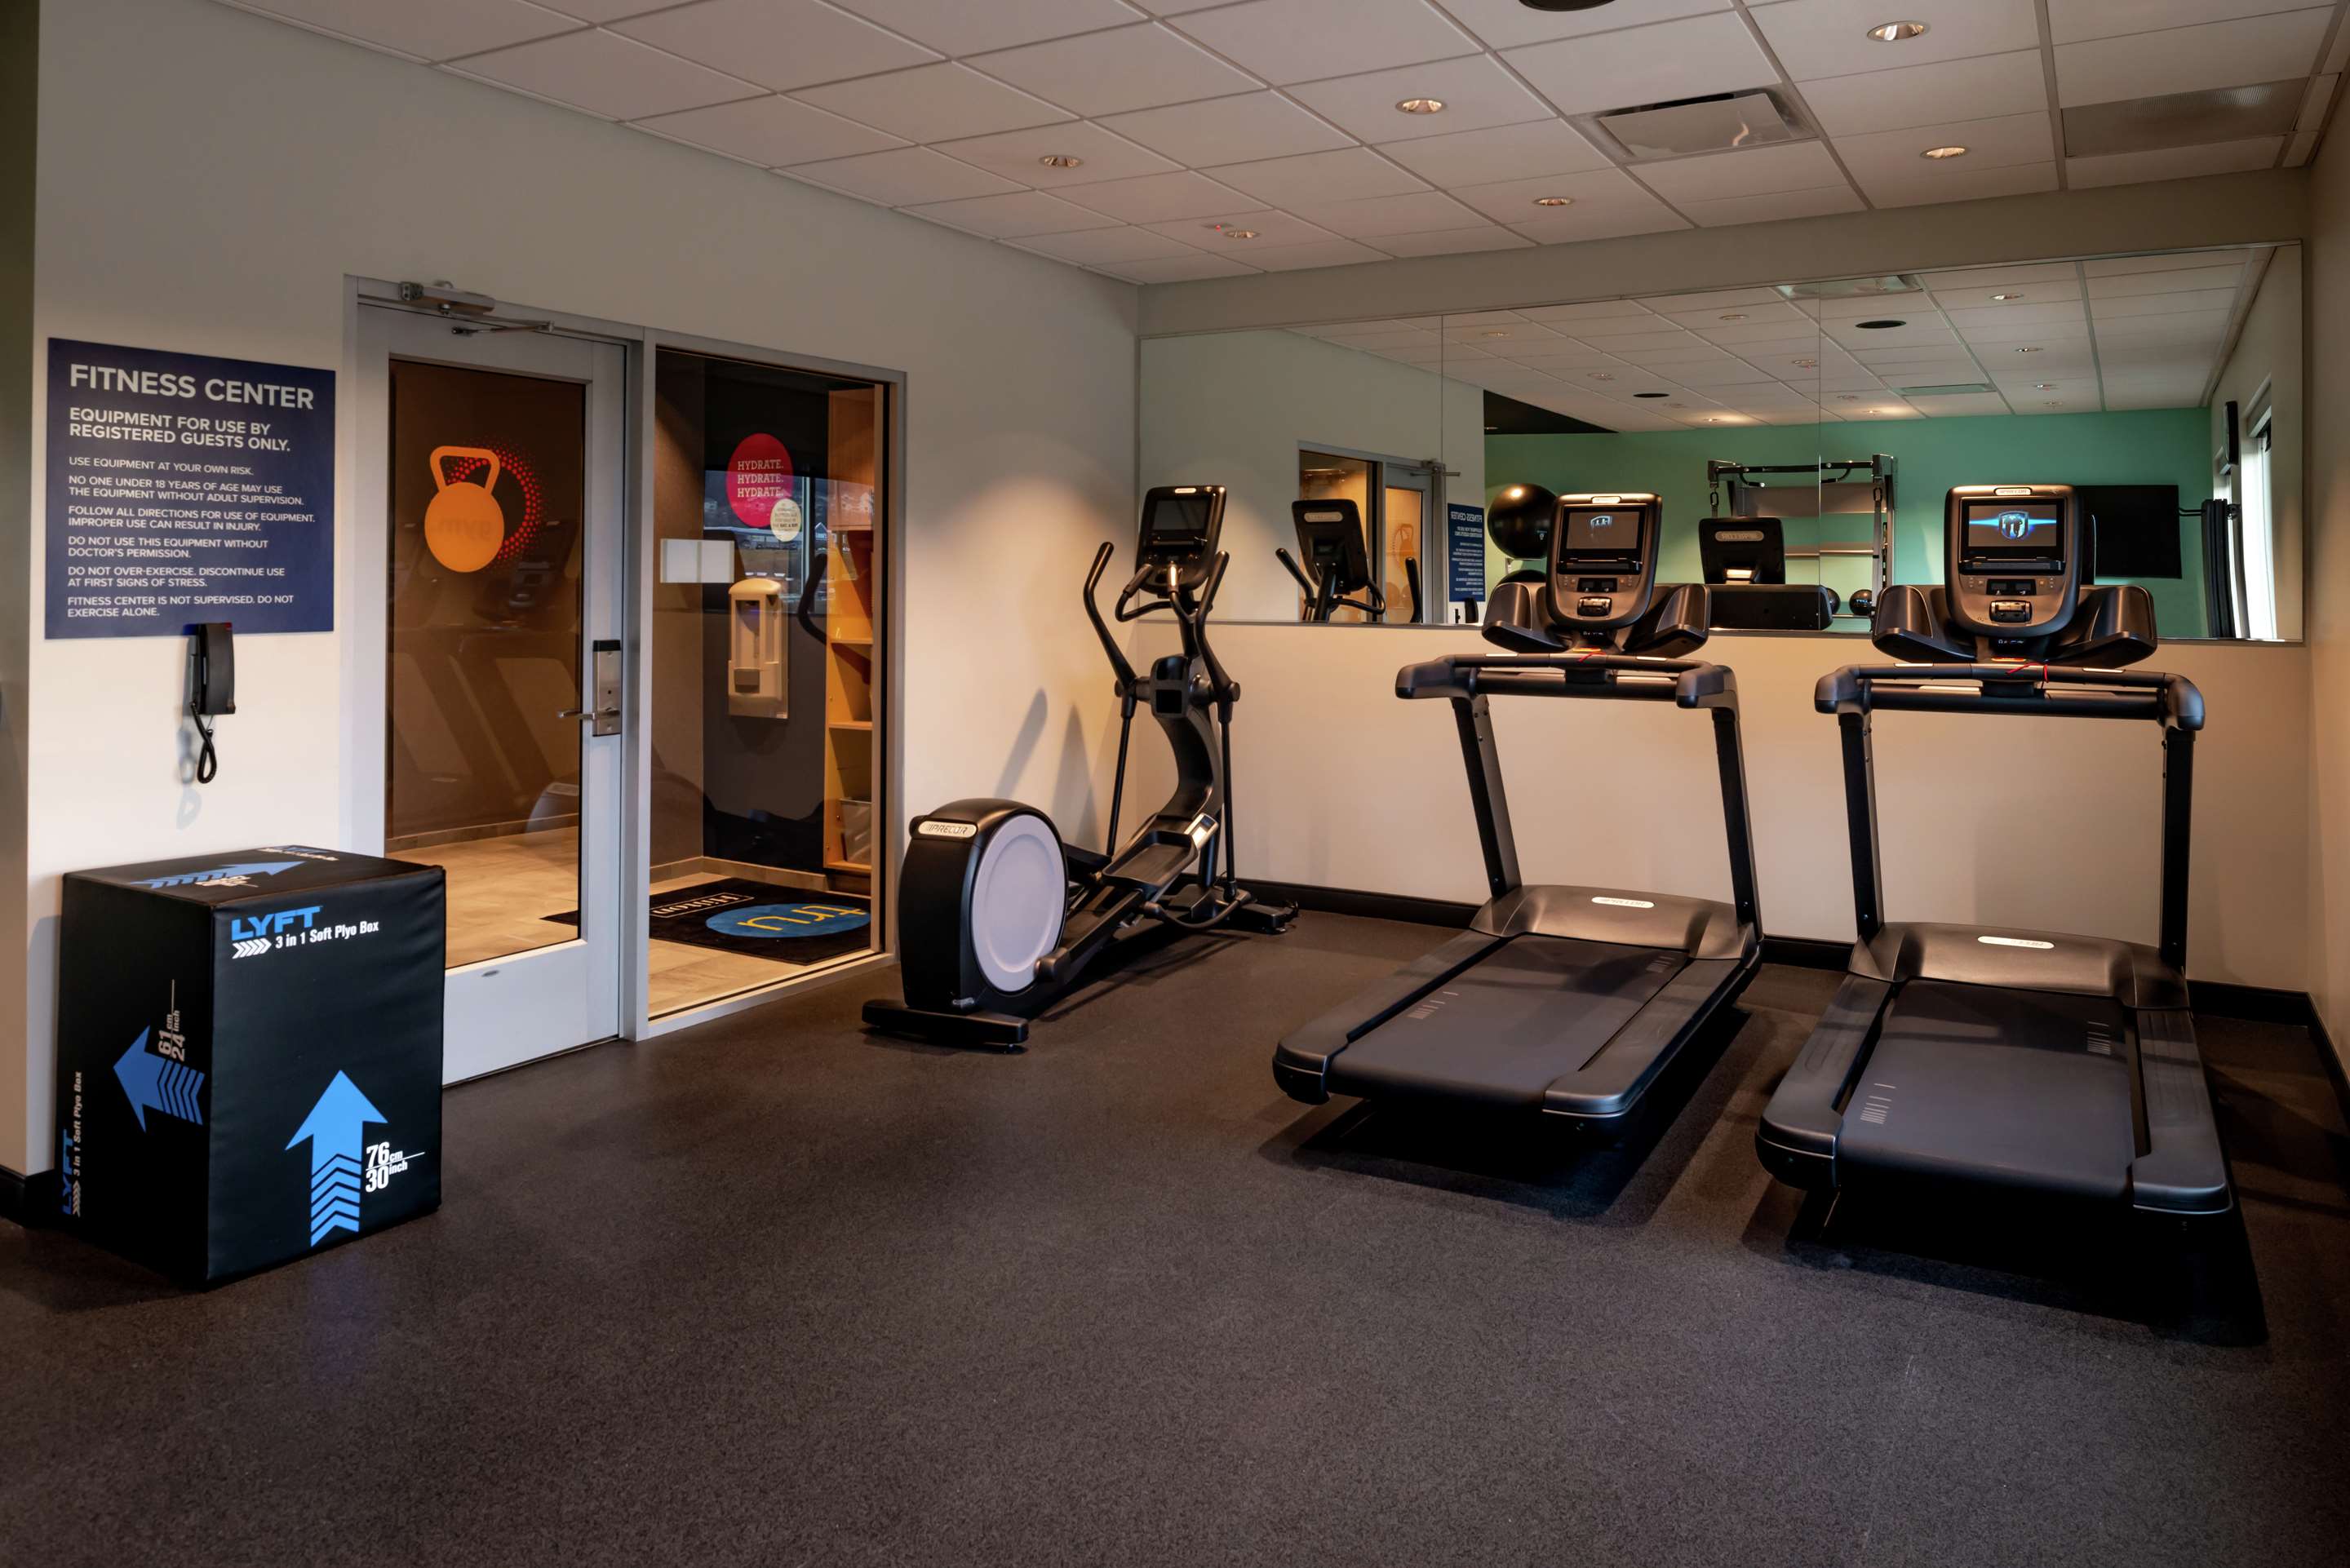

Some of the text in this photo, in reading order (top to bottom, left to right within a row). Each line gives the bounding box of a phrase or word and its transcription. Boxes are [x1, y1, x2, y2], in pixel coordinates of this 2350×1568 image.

[70, 363, 314, 410] FITNESS CENTER
[69, 406, 271, 436] EQUIPMENT FOR USE BY
[69, 423, 290, 452] REGISTERED GUESTS ONLY.
[69, 456, 254, 476] USE EQUIPMENT AT YOUR OWN RISK.
[737, 459, 784, 471] HYDRATE.
[69, 475, 283, 494] NO ONE UNDER 18 YEARS OF AGE MAY USE
[737, 473, 784, 485] HYDRATE.
[69, 486, 304, 506] THE EQUIPMENT WITHOUT ADULT SUPERVISION.
[737, 486, 784, 498] HYDRATE.
[68, 517, 262, 531] IMPROPER USE CAN RESULT IN INJURY.
[69, 505, 316, 523] FOLLOW ALL DIRECTIONS FOR USE OF EQUIPMENT.
[68, 535, 268, 549] DO NOT USE THIS EQUIPMENT WITHOUT
[68, 547, 192, 559] DOCTOR'S PERMISSION.
[68, 566, 285, 576] DO NOT OVER-EXERCISE. DISCONTINUE USE
[67, 578, 208, 587] AT FIRST SIGNS OF STRESS.
[67, 595, 295, 606] FITNESS CENTER IS NOT SUPERVISED. DO NOT
[67, 607, 160, 618] EXERCISE ALONE.
[930, 824, 969, 834] PRECOR
[231, 906, 321, 941] LYFT
[275, 920, 379, 949] 3 in 1 Soft Plyo Box
[158, 1030, 171, 1055] 61
[171, 1034, 186, 1062] 24
[73, 1071, 82, 1092] Box
[73, 1095, 82, 1118] Plyo
[73, 1120, 82, 1143] Soft
[366, 1141, 403, 1169] 76 cm
[365, 1160, 408, 1193] 30 inch
